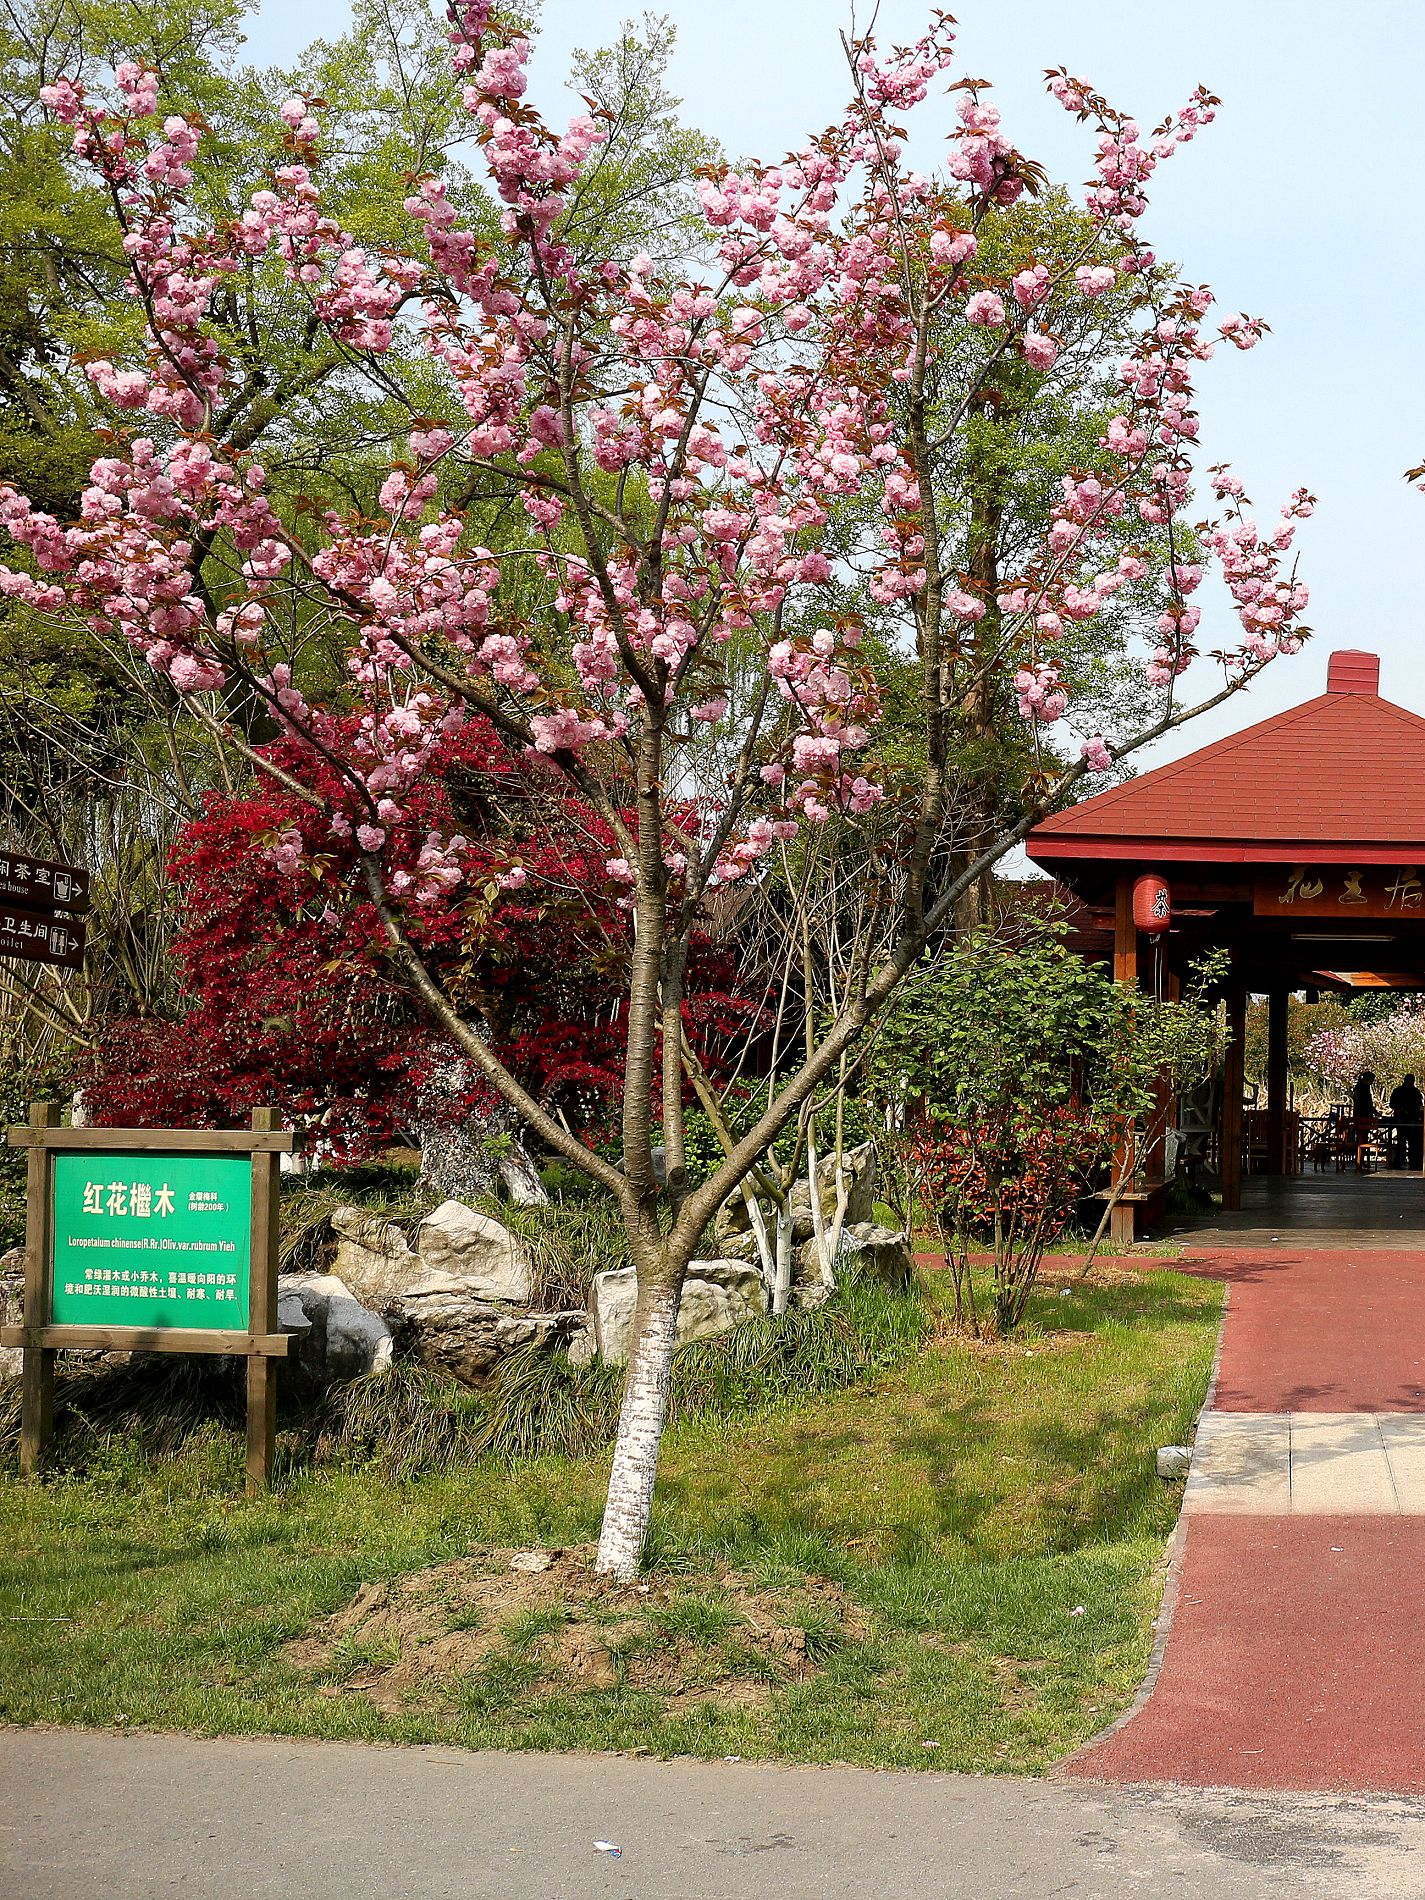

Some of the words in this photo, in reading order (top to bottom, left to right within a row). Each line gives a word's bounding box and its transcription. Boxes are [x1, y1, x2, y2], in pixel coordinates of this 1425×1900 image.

[1150, 888, 1170, 918] 茶
[0, 916, 48, 941] 卫生间
[0, 936, 23, 949] oilet
[68, 1235, 111, 1249] Loropetalum
[218, 1240, 236, 1252] Yieh
